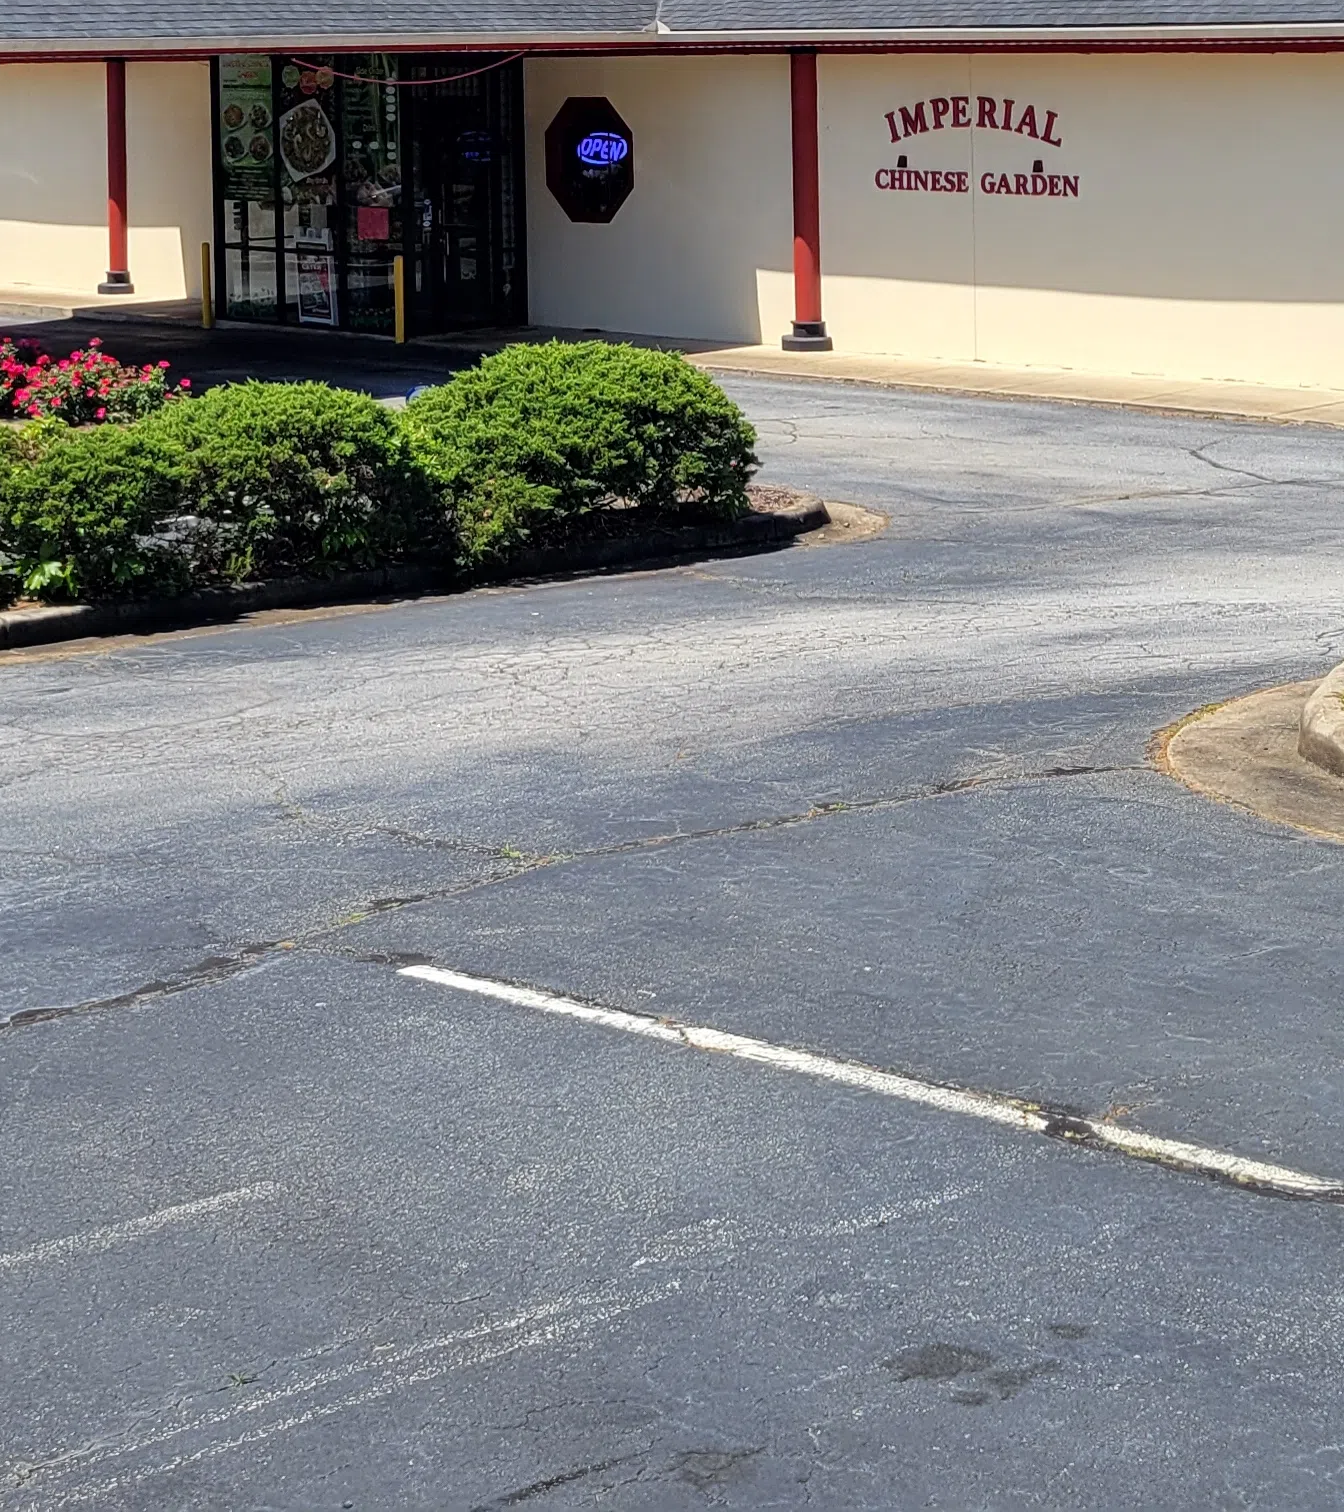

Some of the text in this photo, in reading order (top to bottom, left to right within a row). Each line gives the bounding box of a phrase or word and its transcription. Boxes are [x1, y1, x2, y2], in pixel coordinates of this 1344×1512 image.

[884, 96, 1062, 147] IMPERIAL
[581, 138, 623, 161] OPEN
[874, 168, 1080, 197] CHINESE GARDEN
